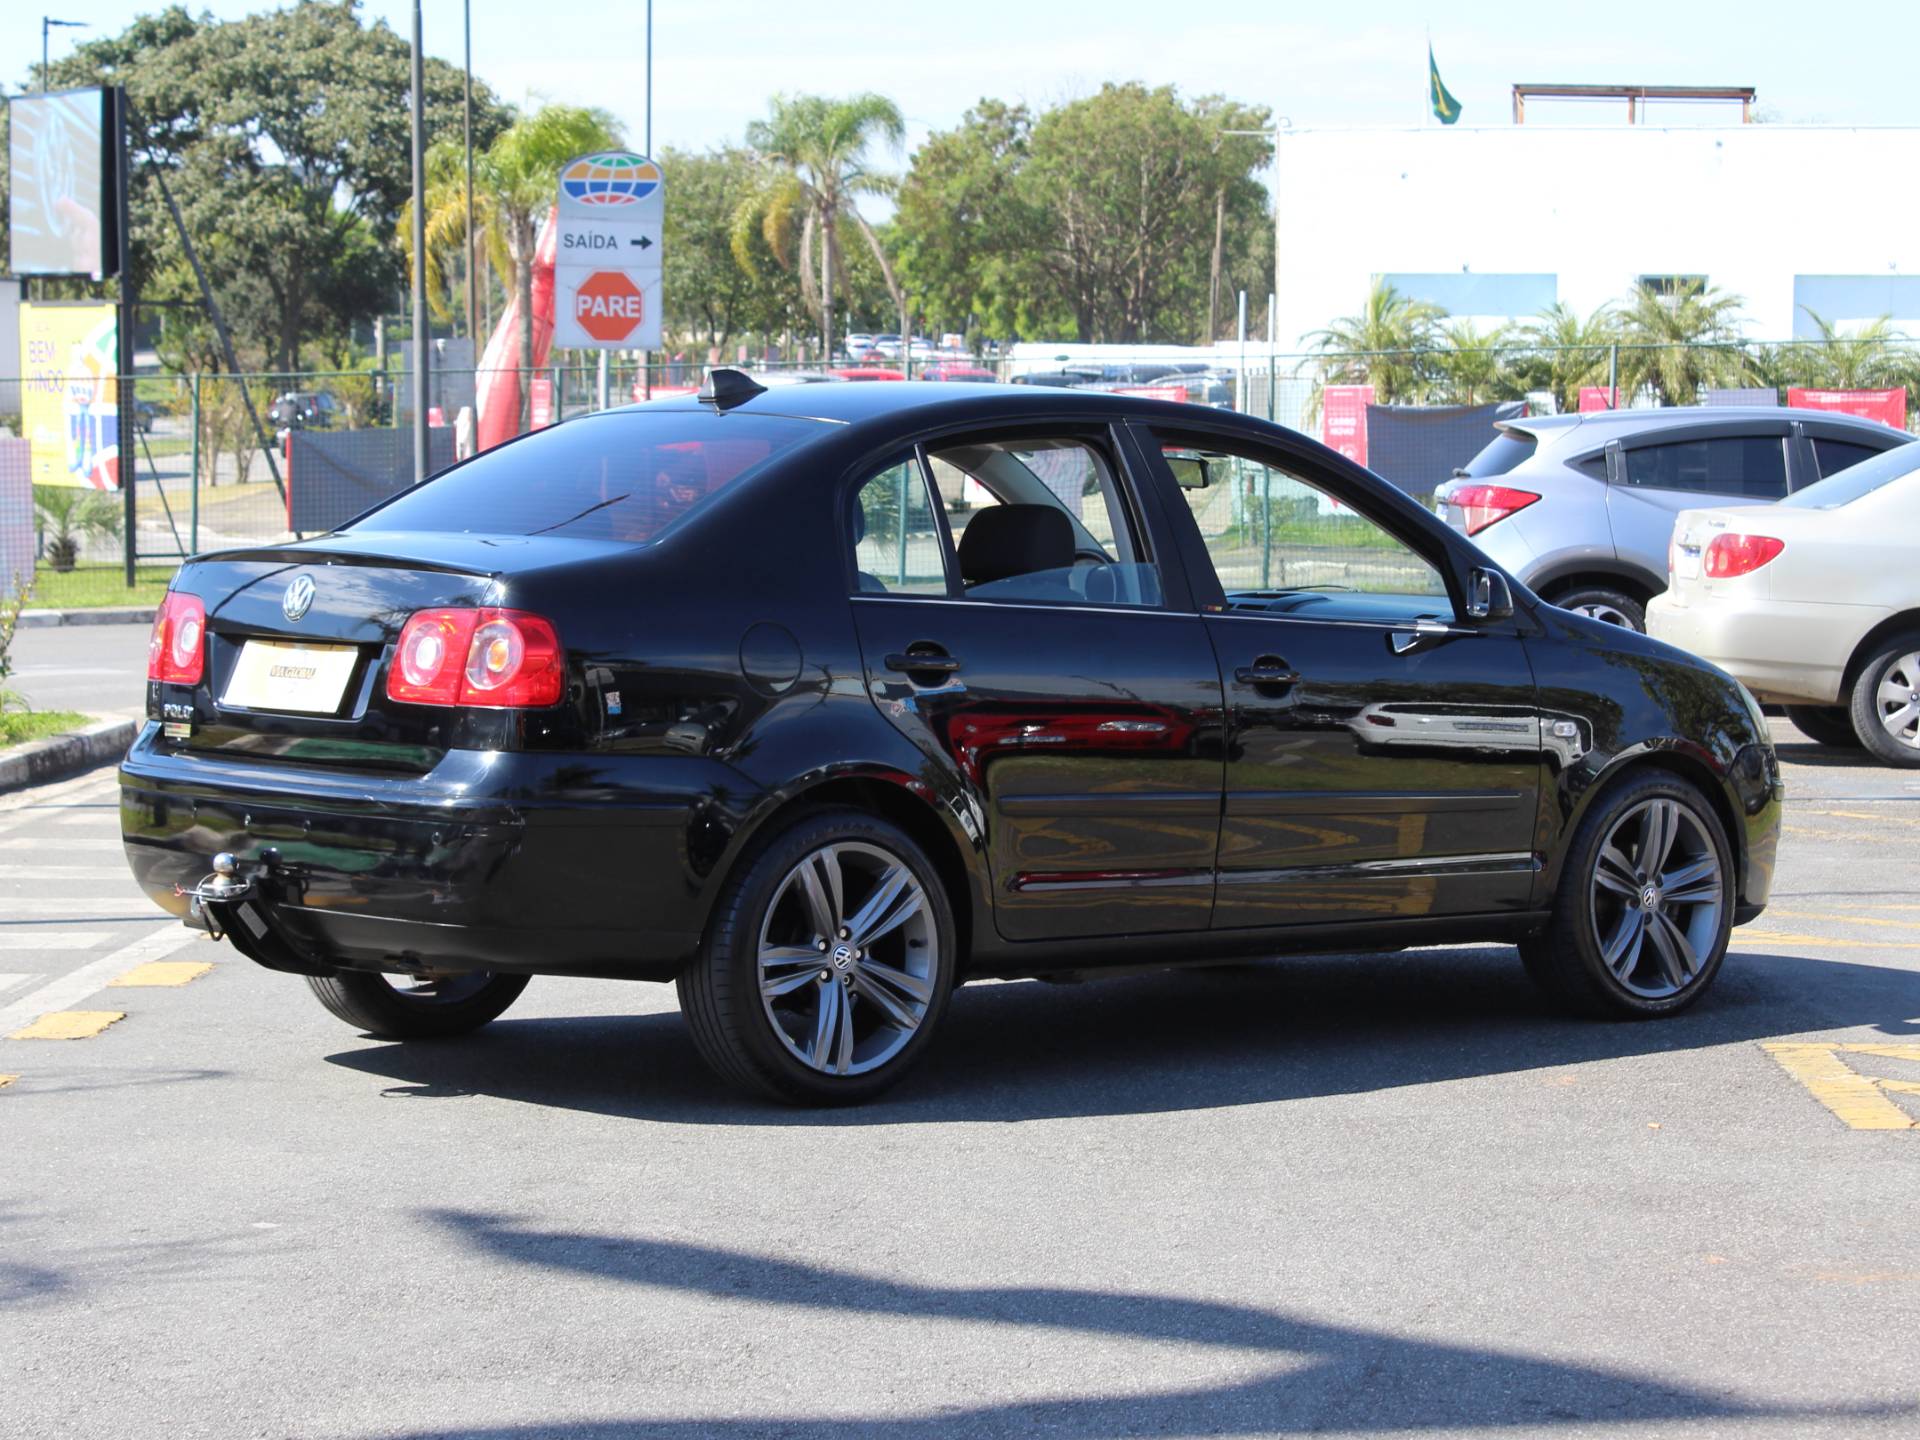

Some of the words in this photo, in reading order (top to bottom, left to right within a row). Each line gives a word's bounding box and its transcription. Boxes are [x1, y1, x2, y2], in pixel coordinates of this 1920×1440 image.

[563, 231, 618, 250] SAÍDA
[577, 295, 641, 319] PARE
[28, 340, 55, 364] BEM
